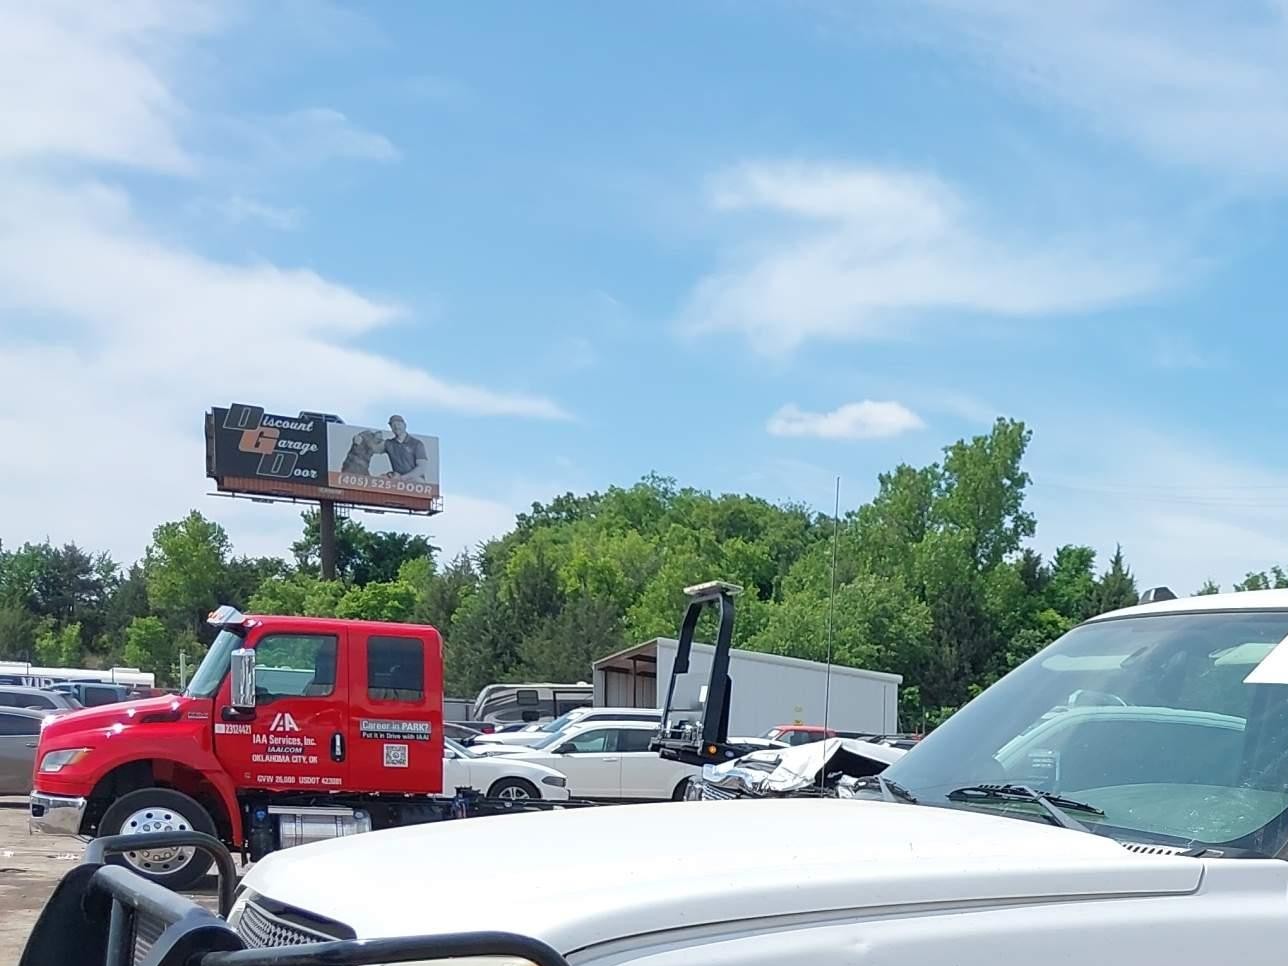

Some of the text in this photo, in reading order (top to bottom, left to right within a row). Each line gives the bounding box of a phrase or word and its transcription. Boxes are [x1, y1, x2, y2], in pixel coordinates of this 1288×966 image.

[223, 403, 314, 431] Discount
[239, 427, 318, 455] Garage
[256, 450, 318, 478] Door
[338, 474, 433, 495] (405) 525-DOOR
[362, 720, 429, 732] Career in PARK?
[252, 734, 317, 746] IAA Services, Inc.
[252, 754, 318, 764] OKLAHOMA CITY, OK
[298, 776, 320, 784] USDOT
